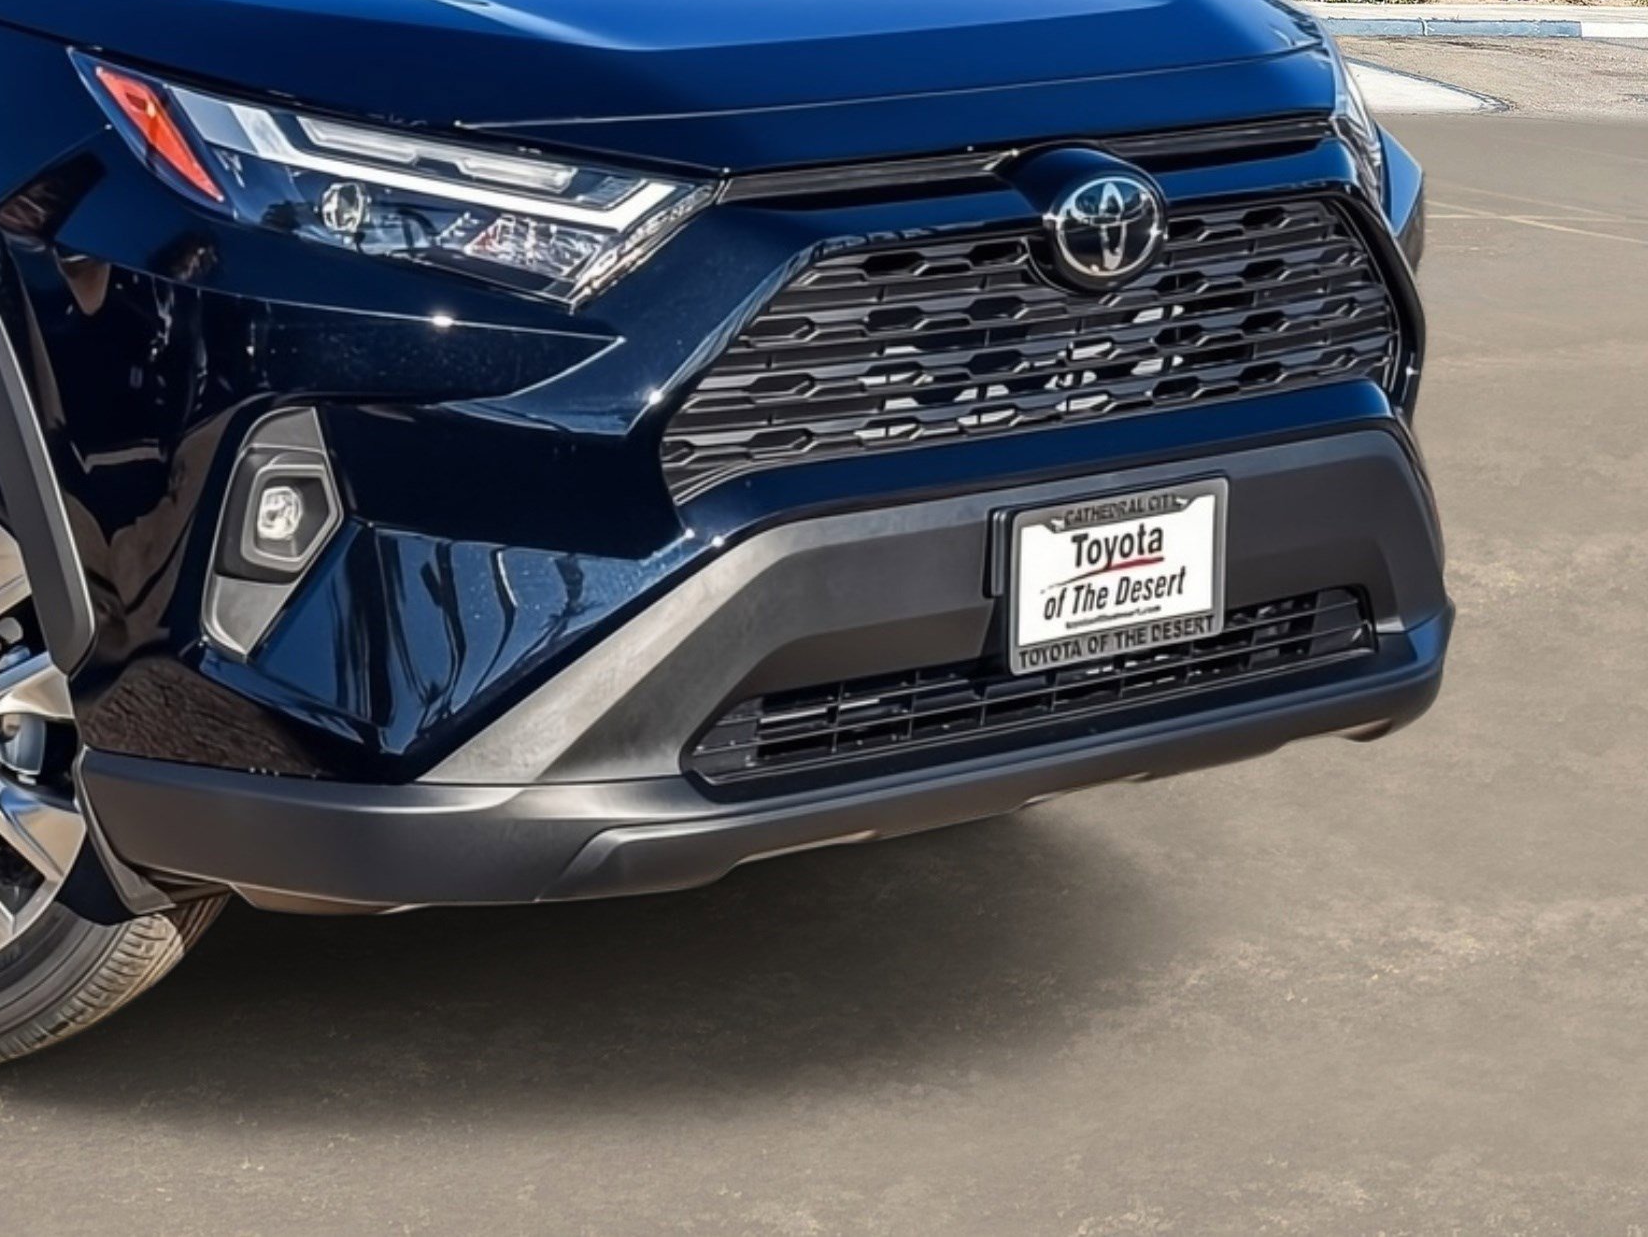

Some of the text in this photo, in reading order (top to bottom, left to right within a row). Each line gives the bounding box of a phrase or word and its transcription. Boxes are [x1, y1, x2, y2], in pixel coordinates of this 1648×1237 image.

[1071, 523, 1163, 570] Toyota
[1044, 587, 1067, 620] of
[1072, 583, 1109, 615] The
[1115, 565, 1186, 605] Desert
[1019, 638, 1082, 668] TOYOTA
[1088, 634, 1109, 654] OF
[1114, 626, 1147, 650] THE
[1152, 614, 1215, 642] DESERT
